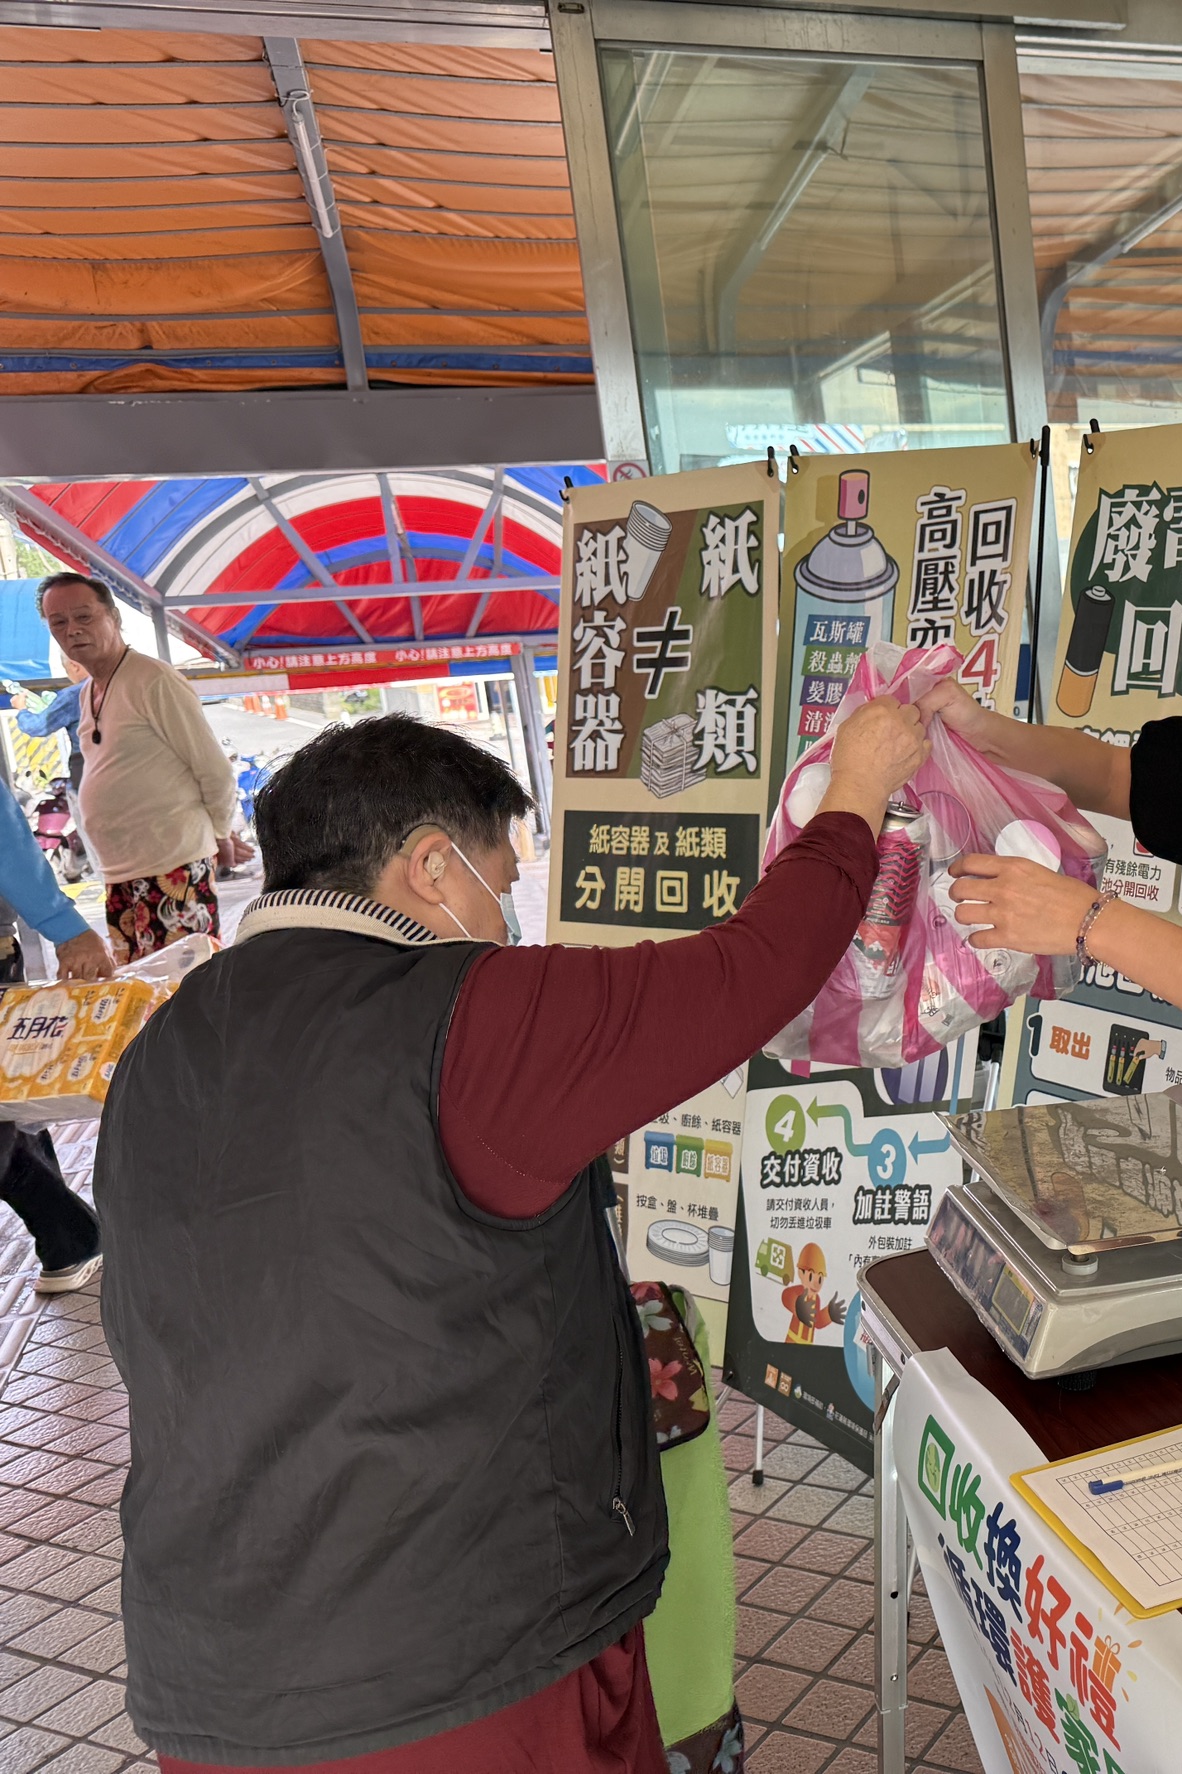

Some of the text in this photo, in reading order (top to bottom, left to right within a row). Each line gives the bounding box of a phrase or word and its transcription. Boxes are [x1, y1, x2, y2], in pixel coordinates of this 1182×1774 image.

[571, 524, 627, 772] 紙容器
[692, 507, 760, 773] 紙類
[810, 620, 865, 644] 瓦斯罐
[575, 865, 740, 917] 分開回收
[7, 1015, 68, 1041] 五月花
[1050, 1025, 1091, 1061] 取出
[774, 1110, 796, 1142] 4
[762, 1152, 842, 1185] 交付資收
[876, 1143, 897, 1180] 3
[855, 1188, 931, 1223] 加註警語
